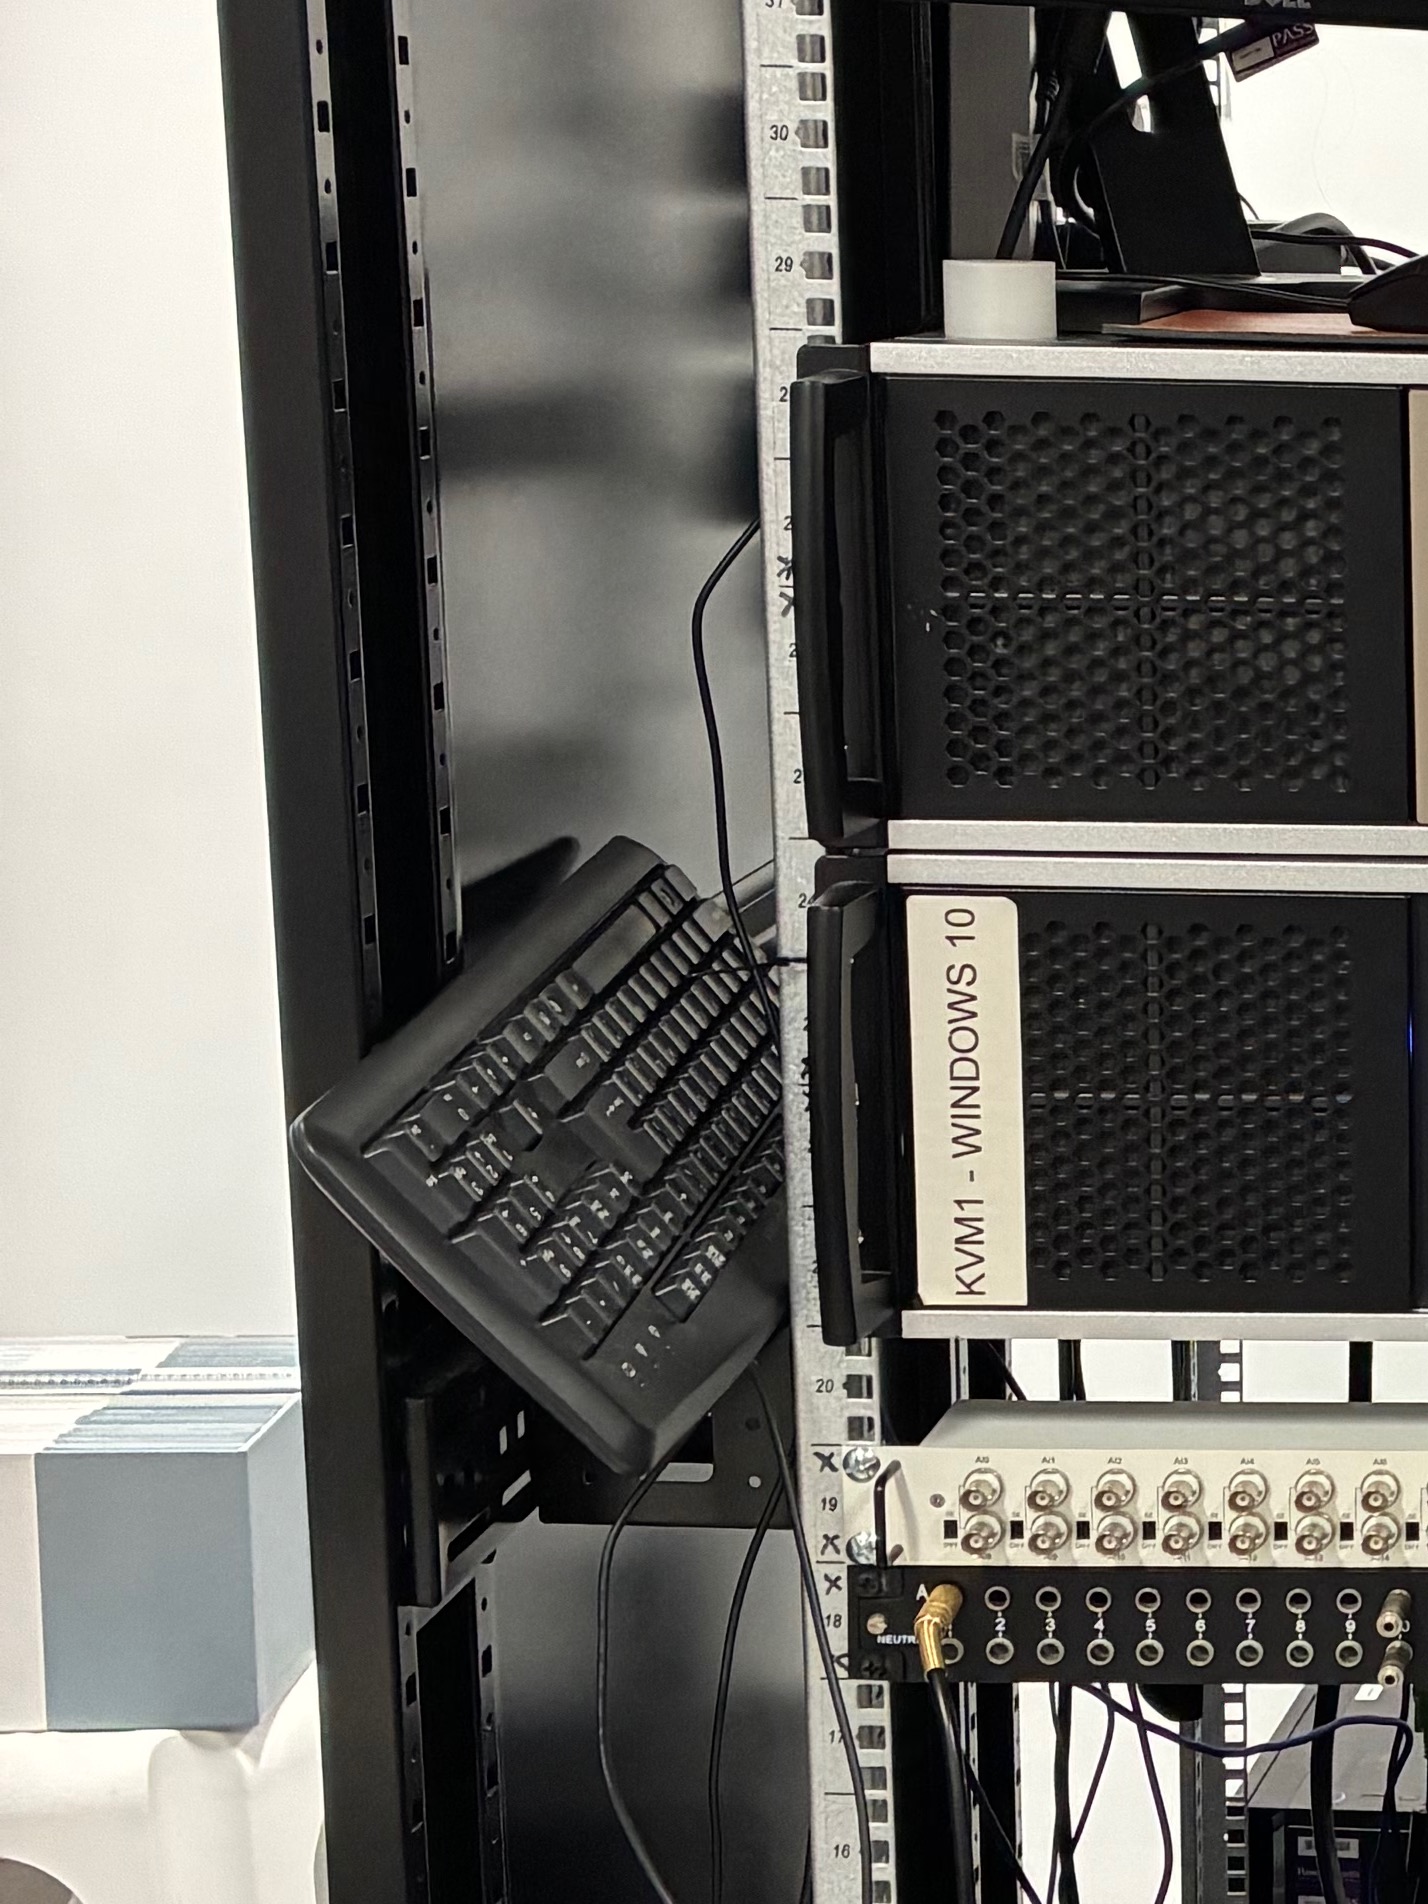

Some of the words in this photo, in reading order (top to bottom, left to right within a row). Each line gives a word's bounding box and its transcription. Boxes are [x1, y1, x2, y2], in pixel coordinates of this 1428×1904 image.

[1271, 23, 1314, 48] PASS
[769, 124, 790, 142] 30
[774, 256, 794, 273] 29
[944, 908, 976, 948] 10
[946, 962, 983, 1159] WINDOWS
[953, 1198, 987, 1296] KVM1
[815, 1379, 835, 1394] 20
[820, 1497, 838, 1513] 19
[916, 1583, 929, 1600] A
[825, 1614, 842, 1629] 18
[995, 1618, 1006, 1632] 2
[1045, 1619, 1056, 1632] 3
[1094, 1619, 1106, 1632] 4
[1146, 1619, 1156, 1632] 5
[1195, 1619, 1206, 1632] 6
[1246, 1620, 1257, 1632] 7
[1295, 1620, 1306, 1632] 8
[1345, 1620, 1356, 1632] 9
[828, 1730, 845, 1745] 17
[833, 1844, 851, 1859] 16
